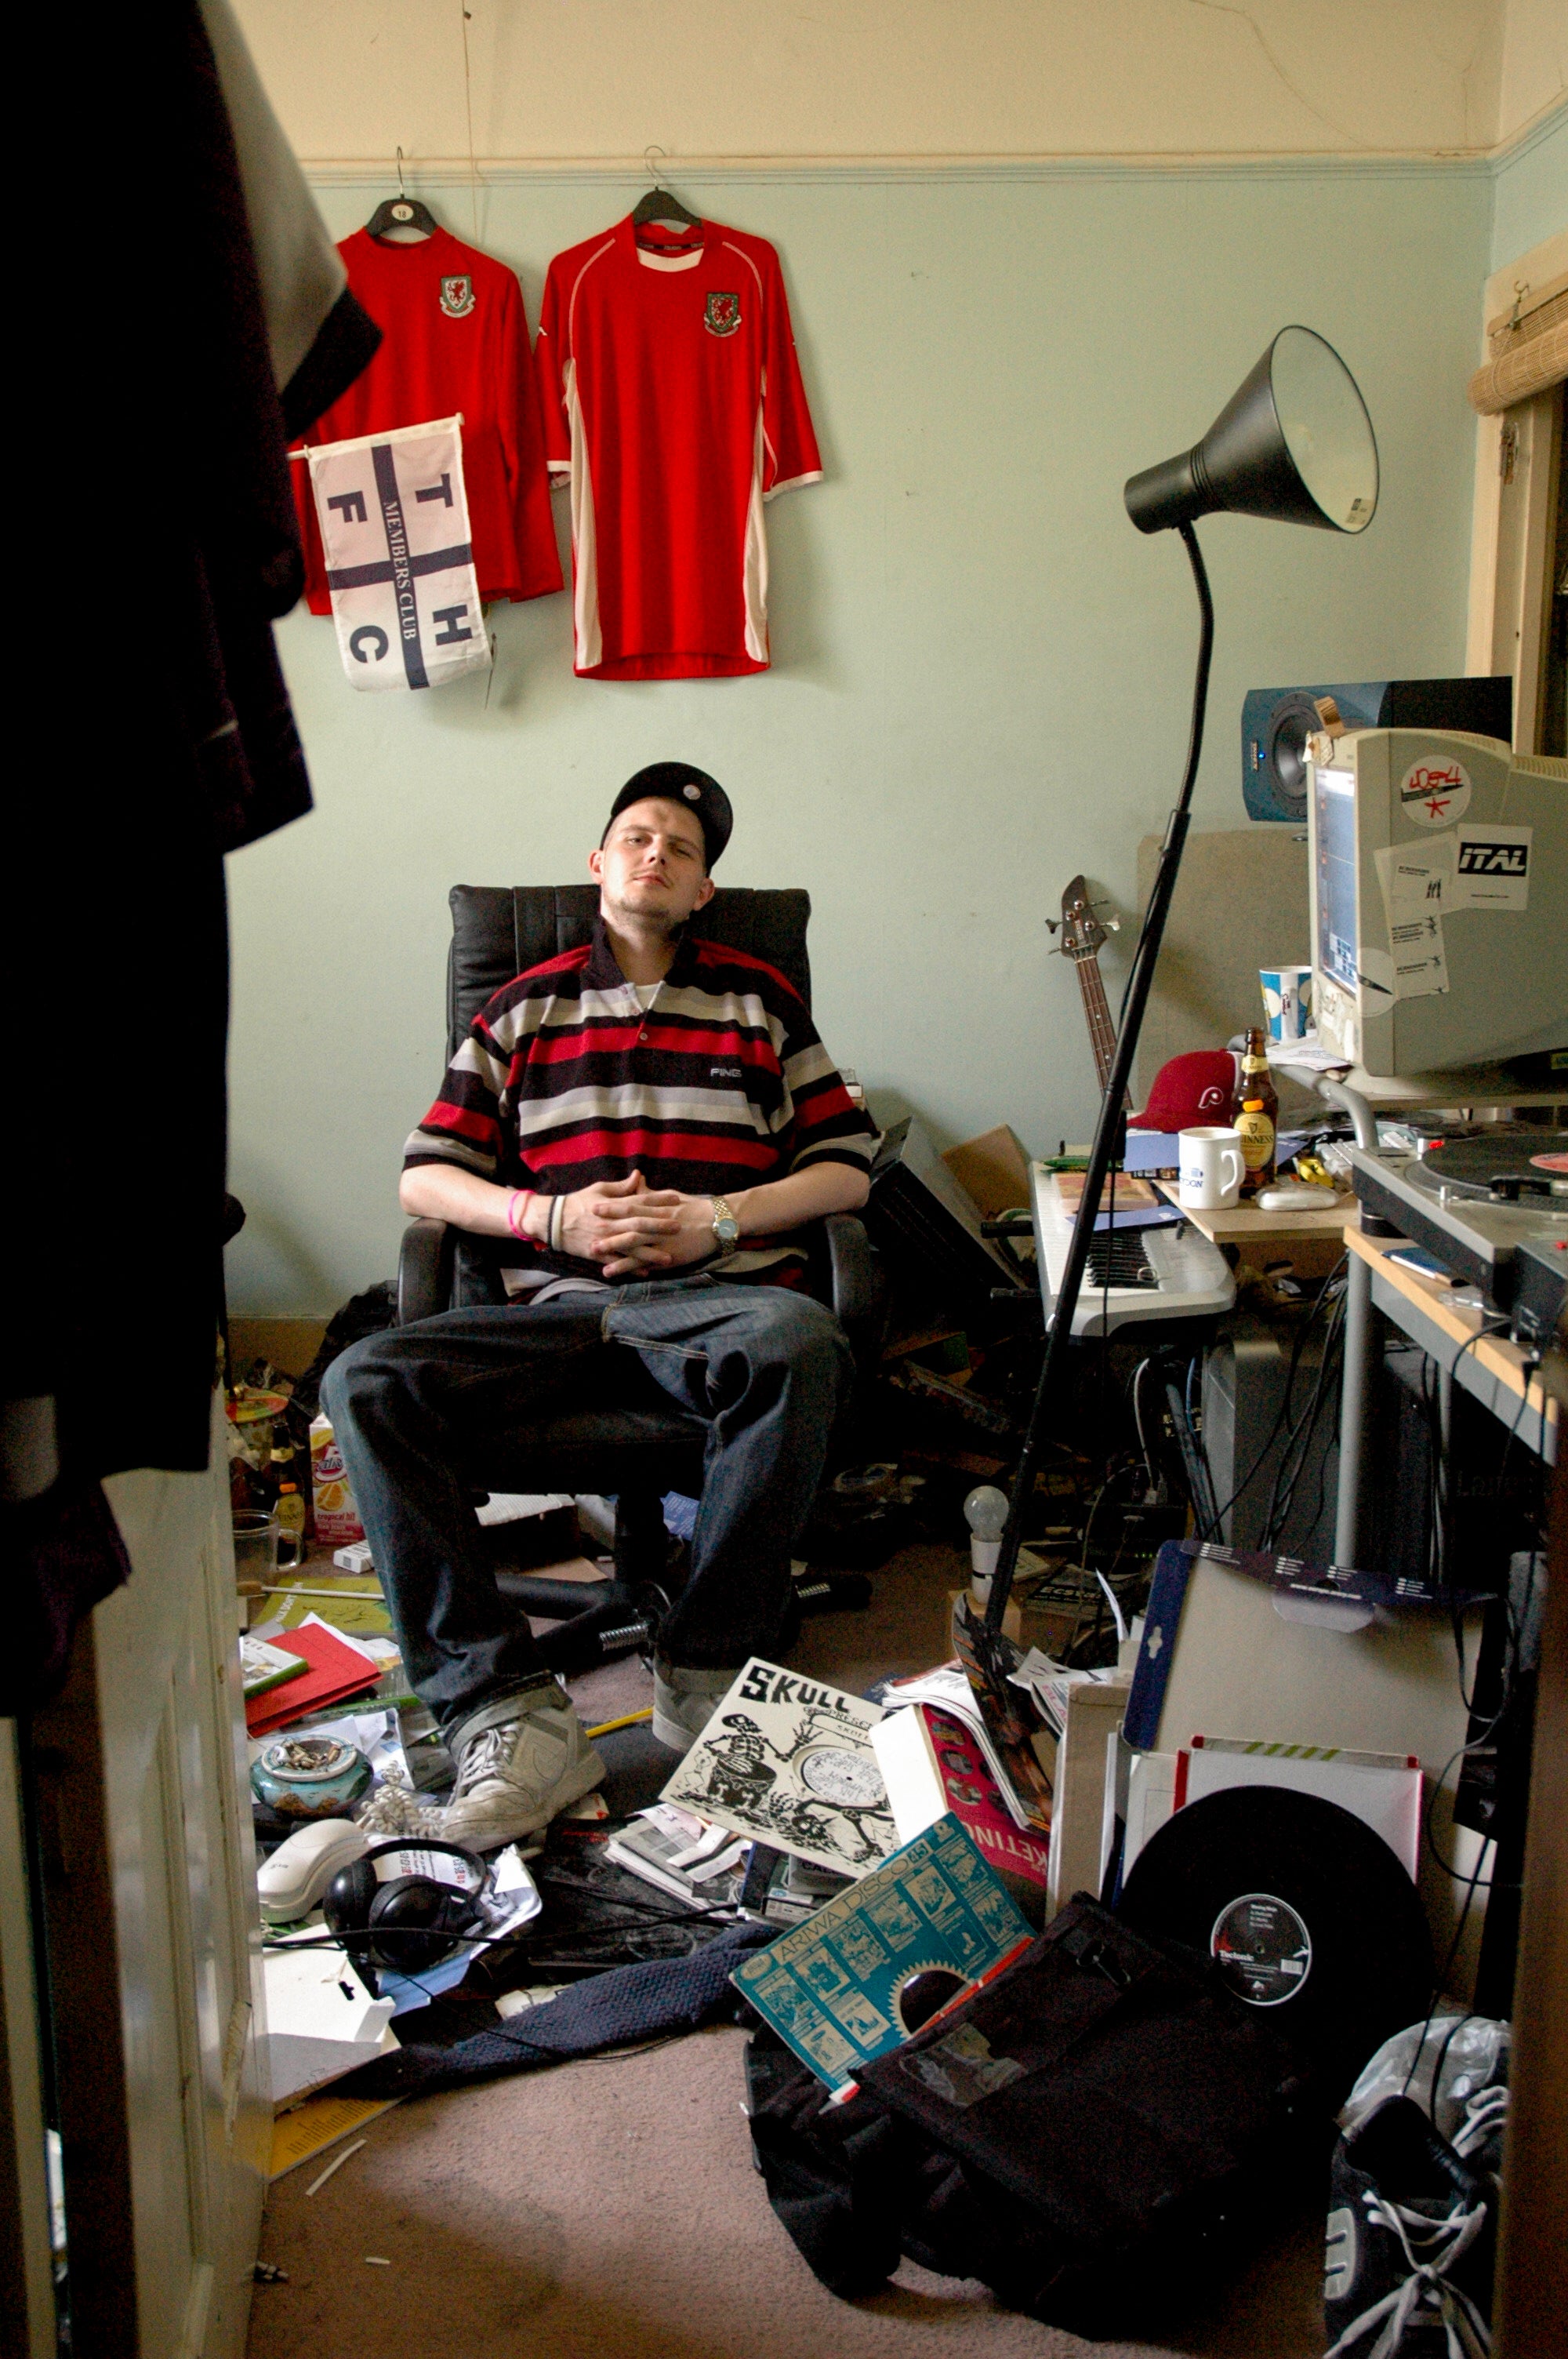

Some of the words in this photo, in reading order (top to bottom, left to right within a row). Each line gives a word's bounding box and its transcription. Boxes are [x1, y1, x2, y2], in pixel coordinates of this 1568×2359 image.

[416, 473, 453, 507] T
[327, 490, 368, 522] F
[350, 625, 388, 663] C
[383, 501, 411, 589] MEMBERS
[398, 592, 417, 640] CLUB
[432, 604, 473, 646] H
[710, 1068, 742, 1078] PING
[739, 1665, 850, 1714] SKULL
[780, 1911, 842, 1961] ARIWA
[843, 1857, 910, 1911] DISCO
[909, 1845, 928, 1863] 45
